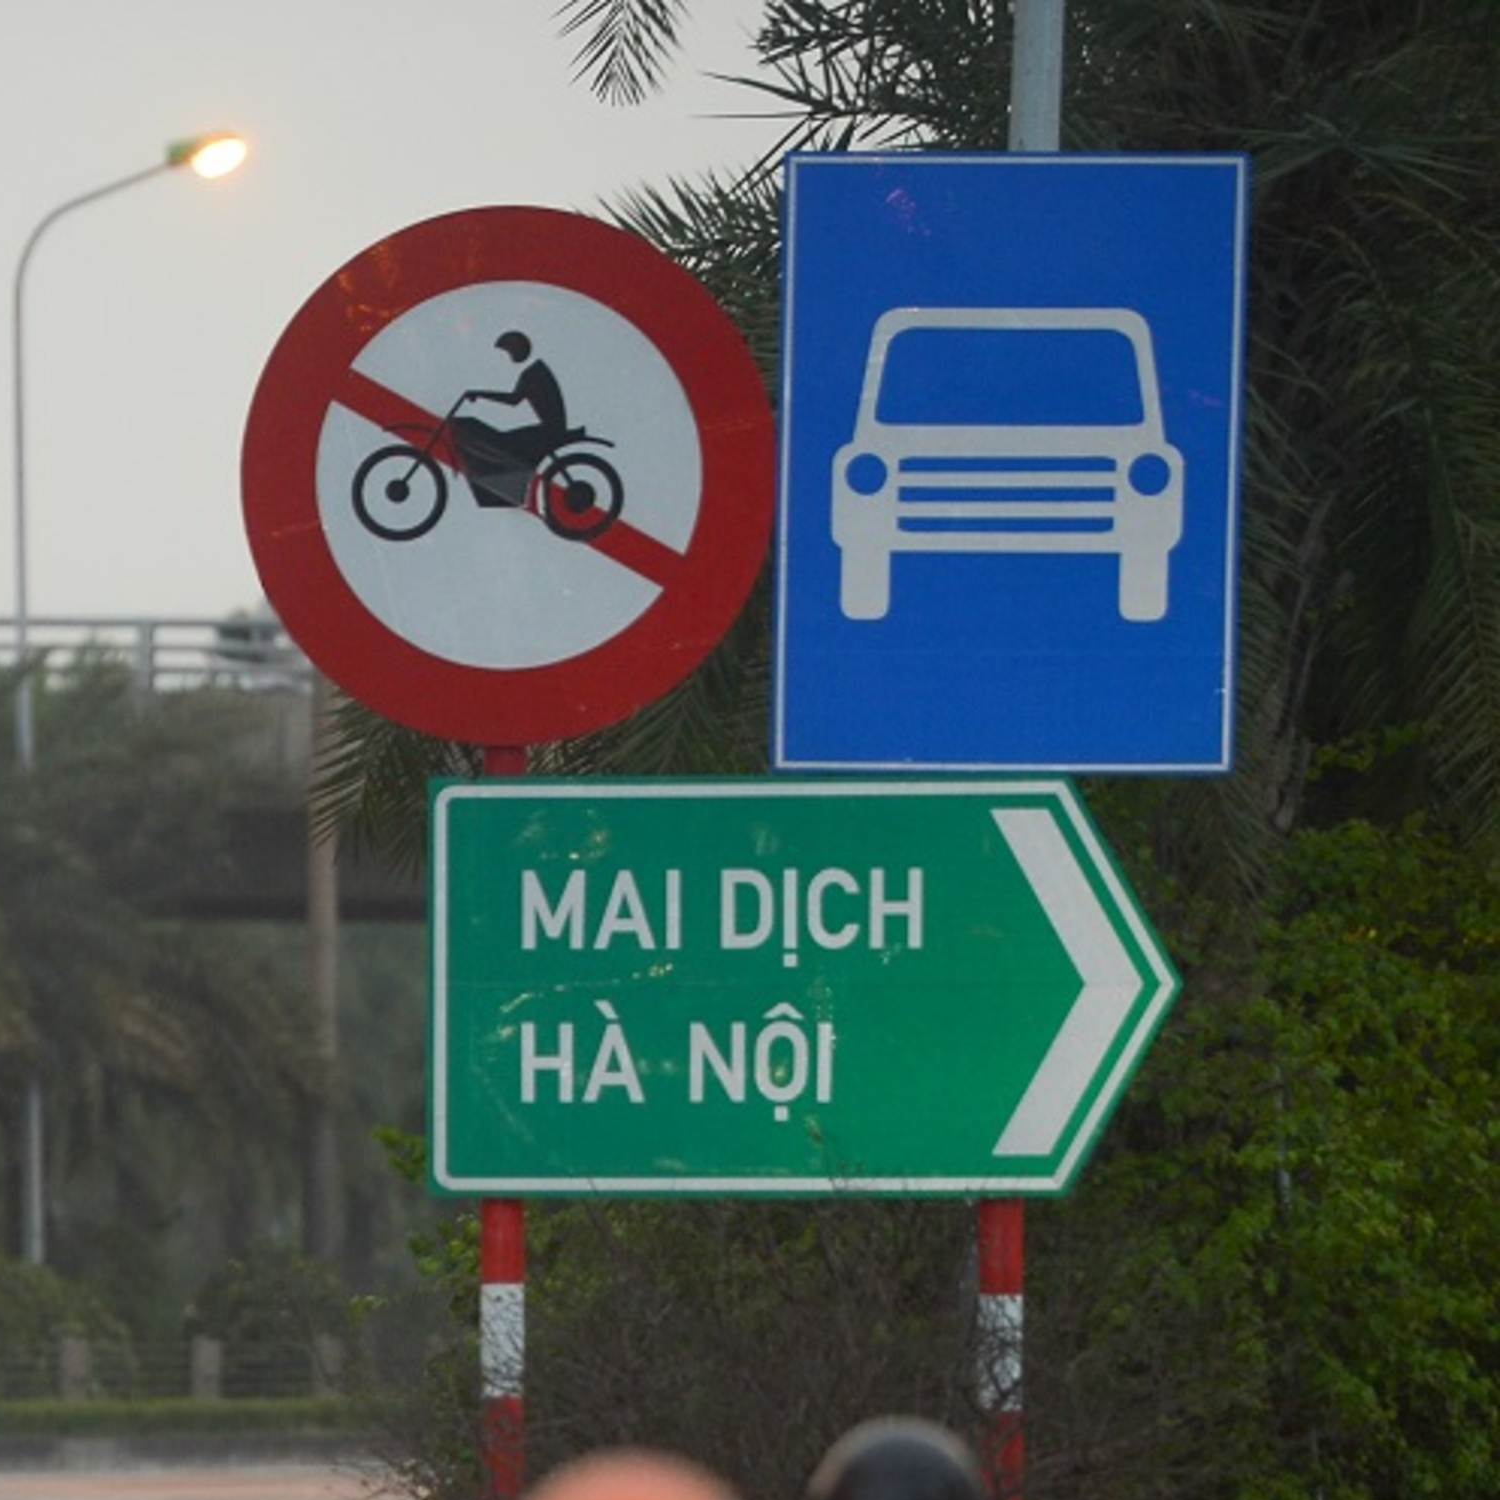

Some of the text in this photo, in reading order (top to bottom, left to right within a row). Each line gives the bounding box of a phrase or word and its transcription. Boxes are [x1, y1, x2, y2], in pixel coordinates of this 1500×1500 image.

[520, 867, 924, 968] MAI DỊCH
[519, 1000, 834, 1121] HÀ NỘI
